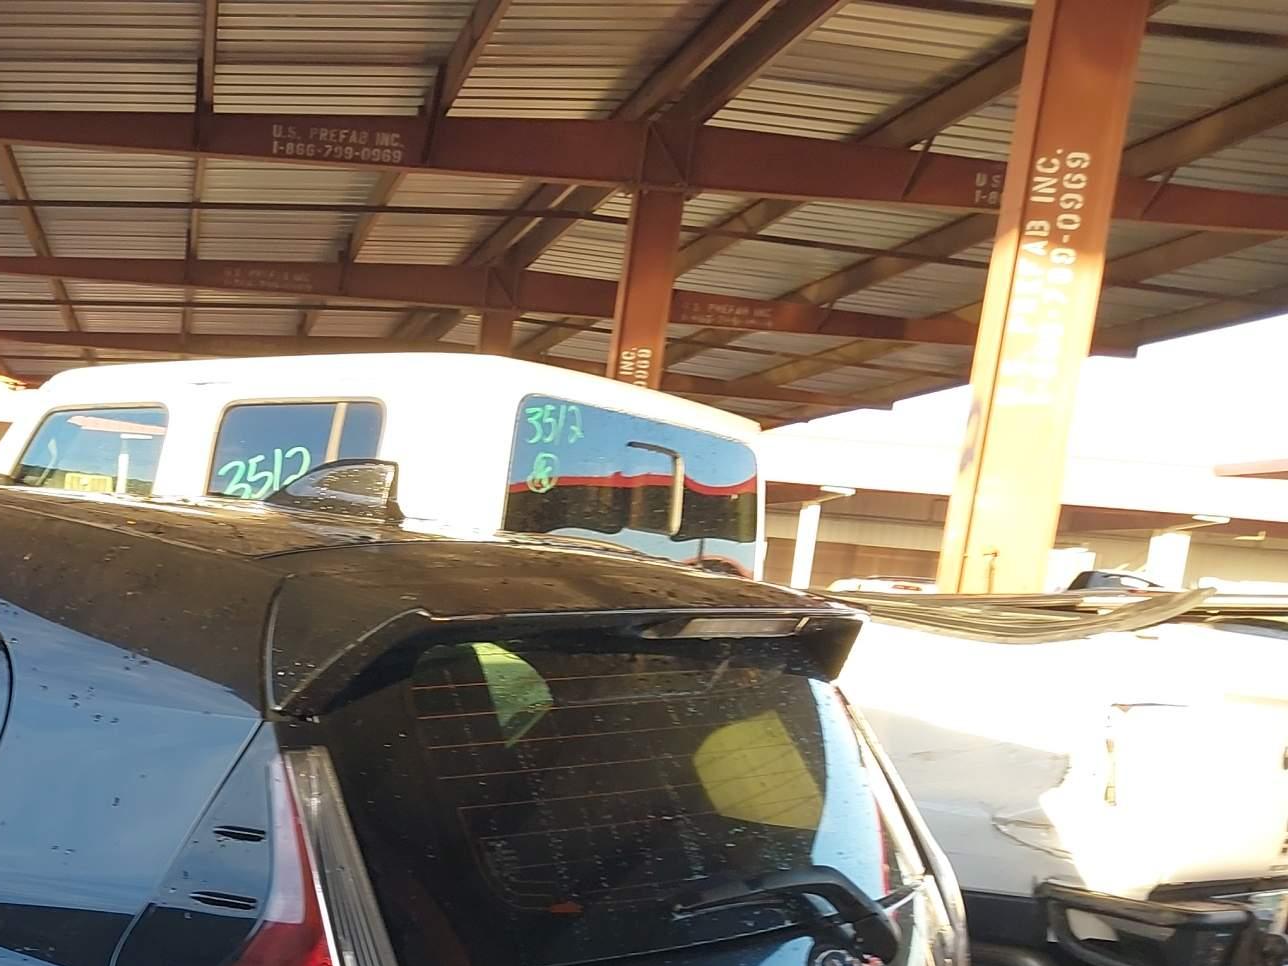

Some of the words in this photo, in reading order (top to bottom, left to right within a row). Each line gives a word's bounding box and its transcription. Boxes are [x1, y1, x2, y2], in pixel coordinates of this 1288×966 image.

[272, 141, 403, 163] 1-866-799-0969
[310, 127, 369, 145] PREFAB
[375, 132, 405, 148] INC.
[1029, 148, 1063, 203] INC.
[619, 347, 638, 375] INC.
[524, 404, 585, 444] 3512
[217, 446, 311, 500] 3512
